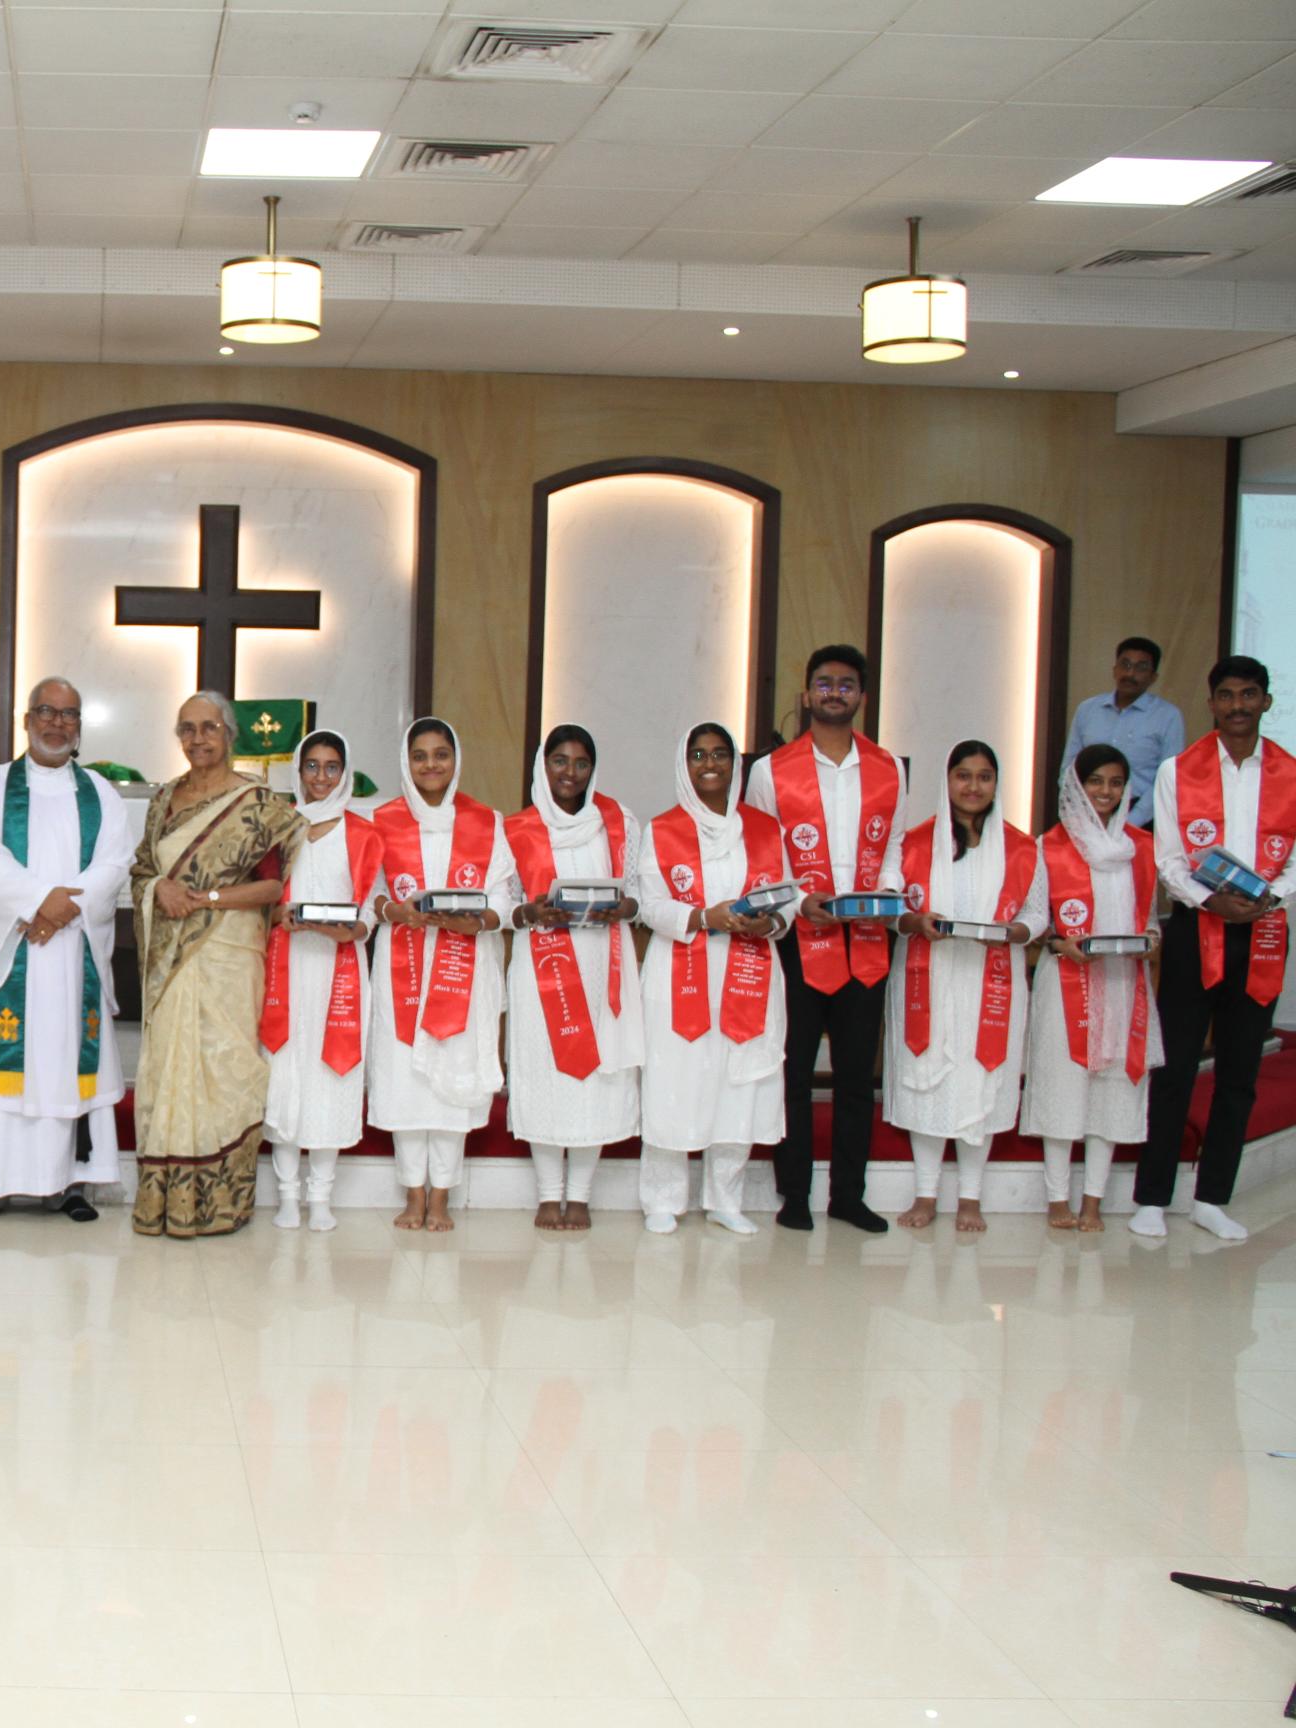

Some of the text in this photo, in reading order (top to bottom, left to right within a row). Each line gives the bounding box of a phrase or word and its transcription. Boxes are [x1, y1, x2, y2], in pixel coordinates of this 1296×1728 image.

[800, 851, 817, 861] CSI
[1066, 928, 1085, 937] CSI
[538, 934, 558, 945] CSI
[560, 1025, 581, 1036] 2024
